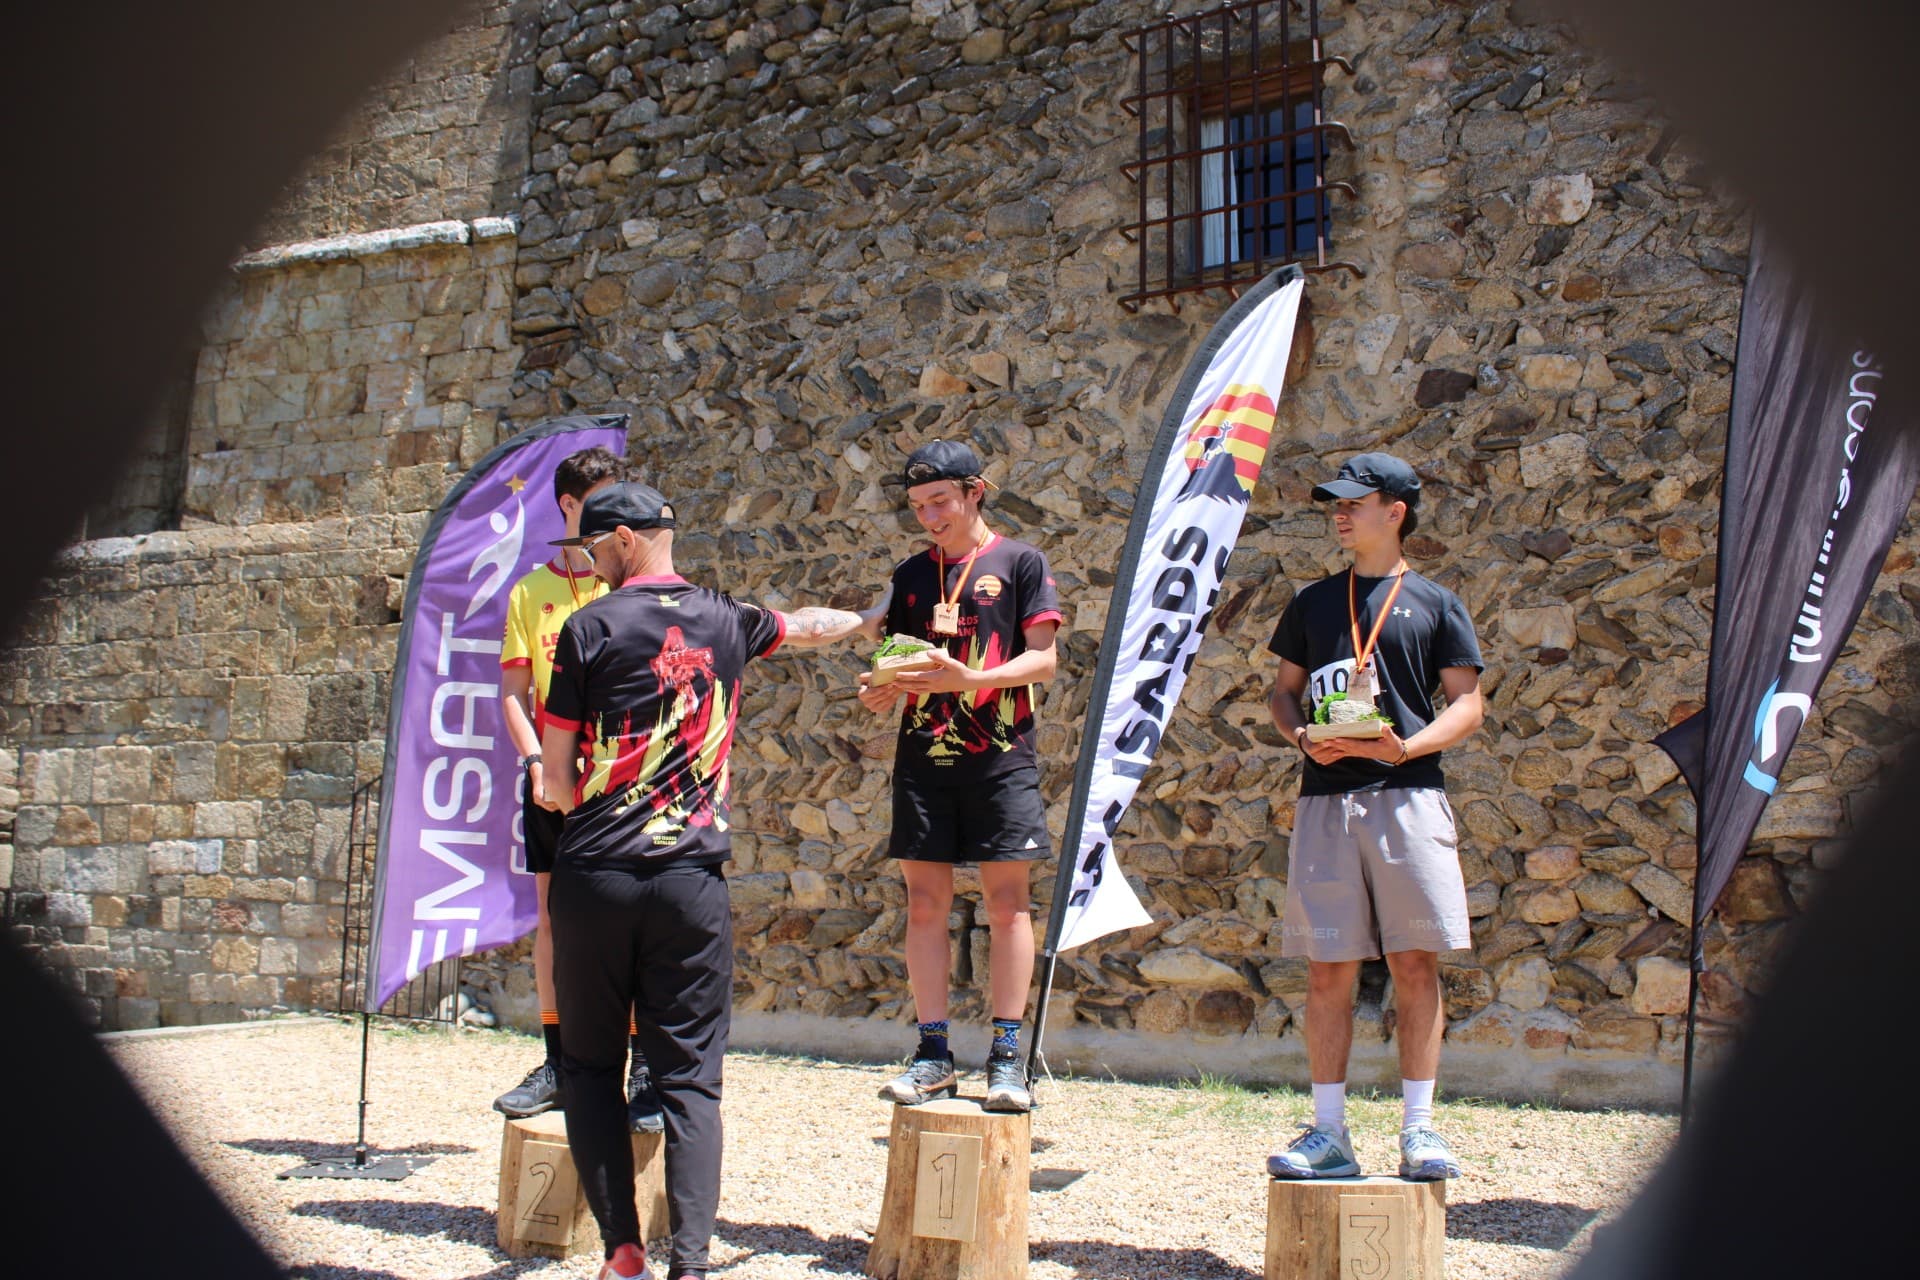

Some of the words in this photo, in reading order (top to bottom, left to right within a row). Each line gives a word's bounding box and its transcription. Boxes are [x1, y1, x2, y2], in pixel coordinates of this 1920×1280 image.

[1111, 525, 1209, 782] ISARDS
[1315, 664, 1352, 704] 10
[405, 612, 503, 978] EMSAT
[521, 1161, 559, 1226] 2
[931, 1152, 957, 1219] 1
[1349, 1214, 1391, 1280] 3
